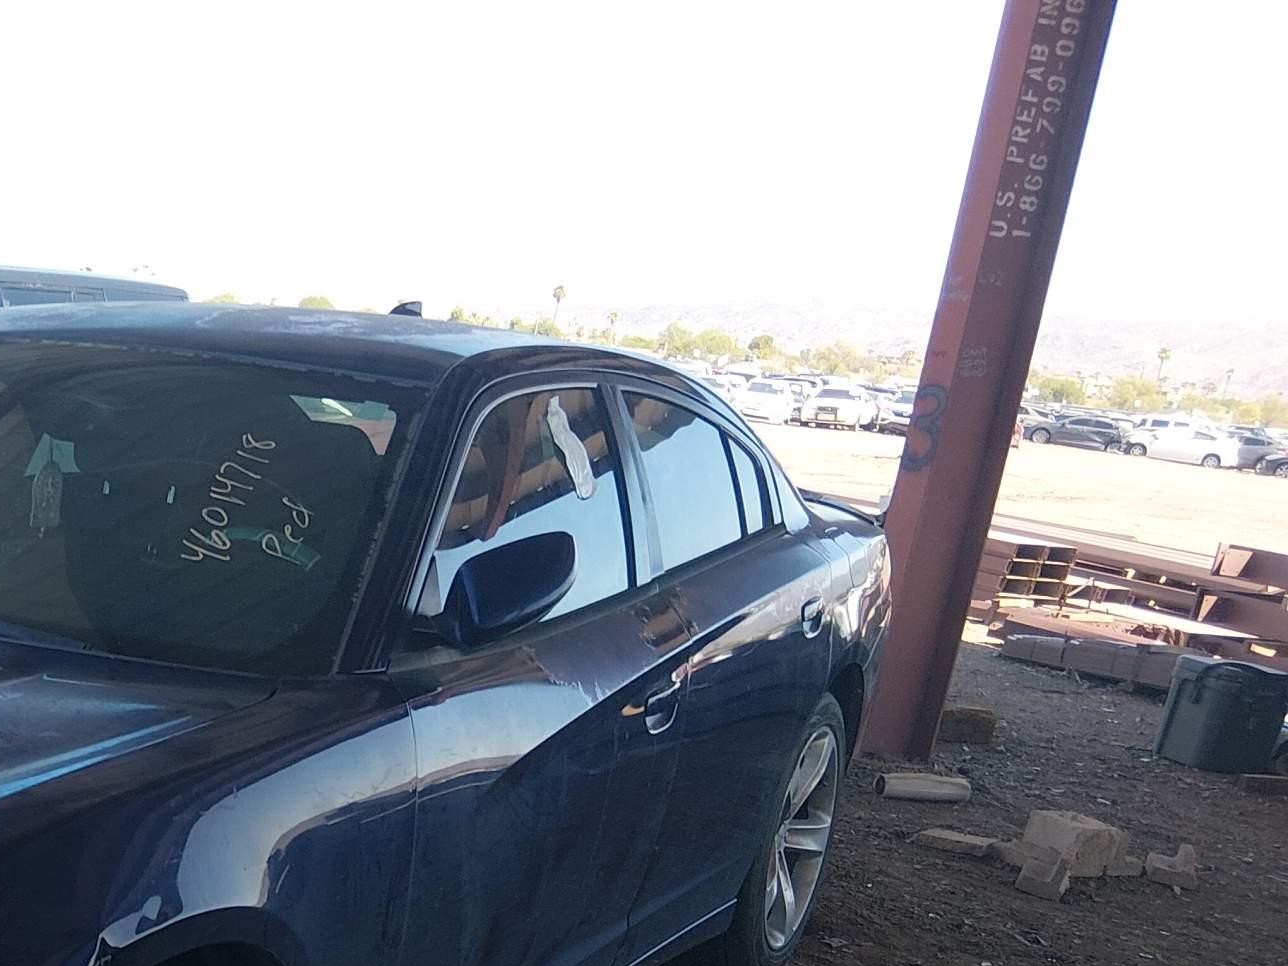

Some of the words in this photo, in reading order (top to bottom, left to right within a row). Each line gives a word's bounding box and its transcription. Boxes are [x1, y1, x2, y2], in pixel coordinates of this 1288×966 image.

[989, 182, 1018, 238] U.S.
[1006, 43, 1049, 163] PREFAB
[180, 433, 276, 561] 46014718
